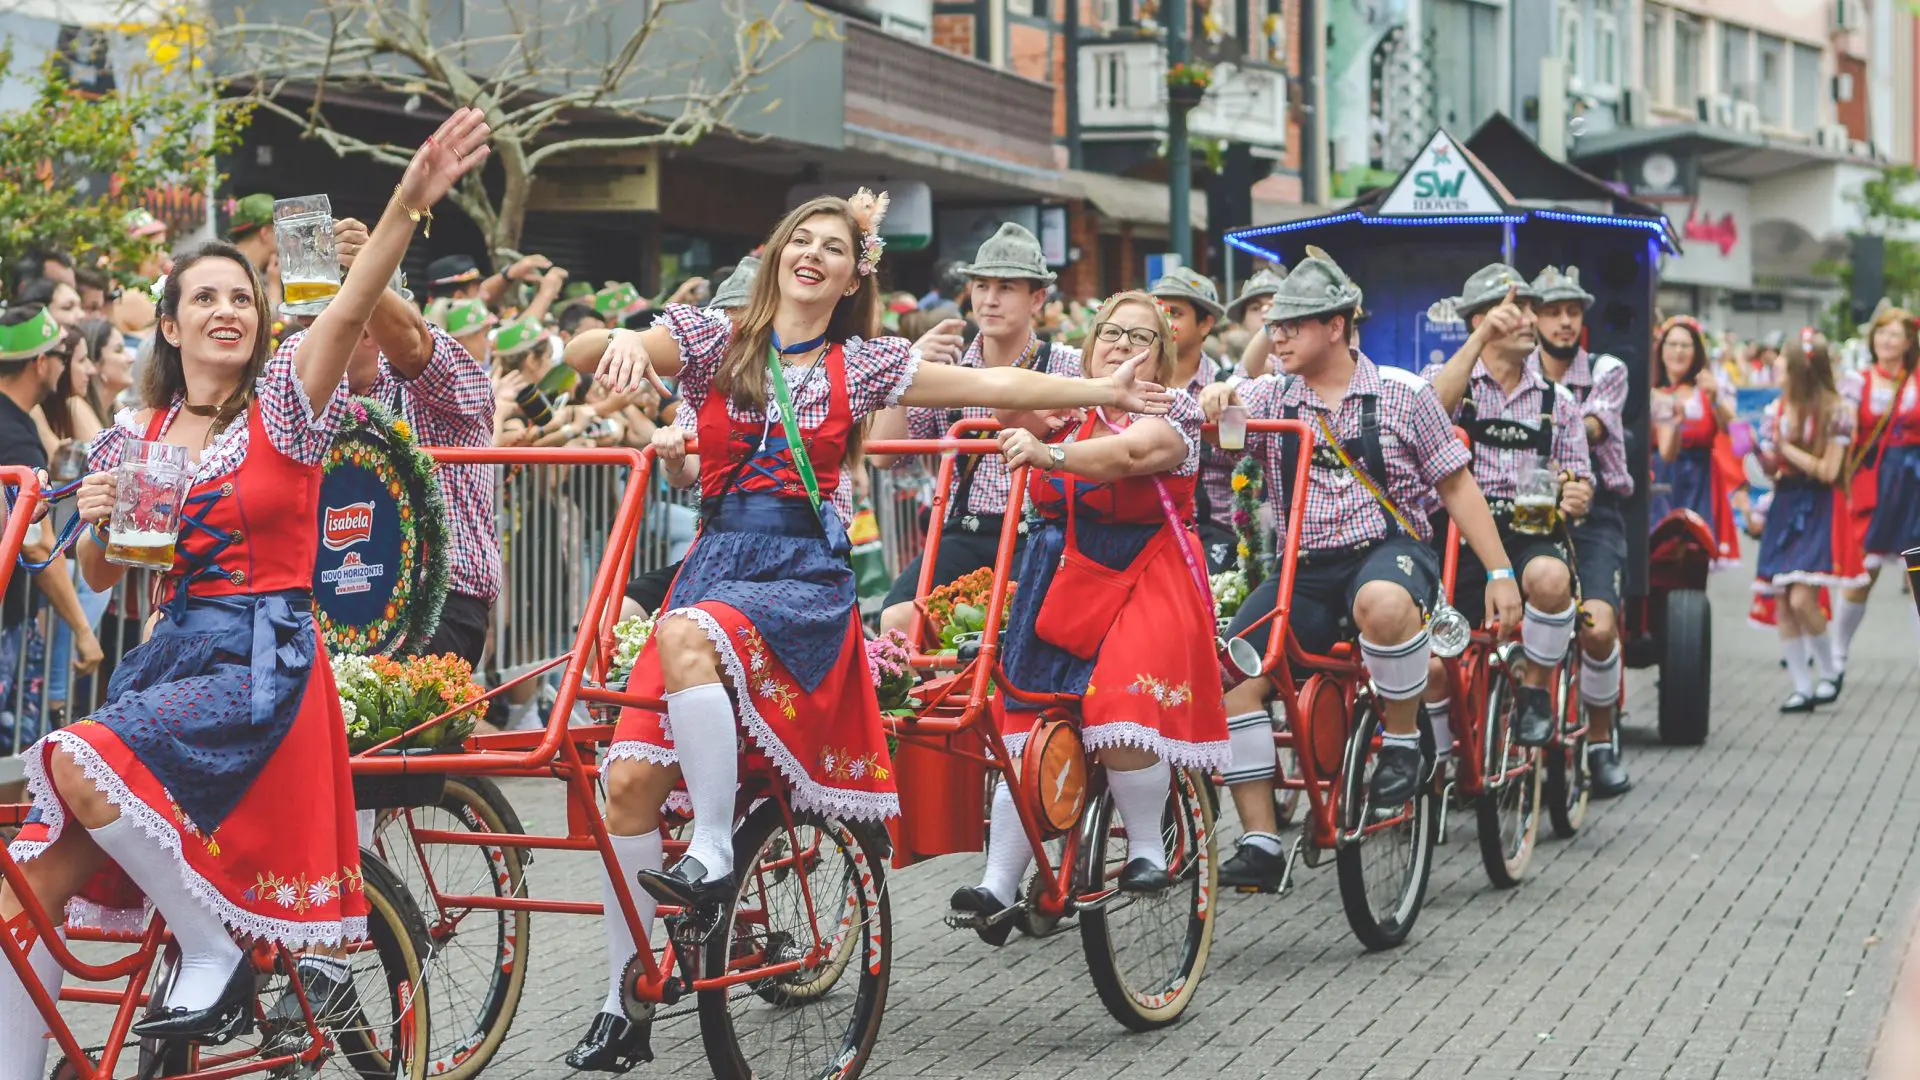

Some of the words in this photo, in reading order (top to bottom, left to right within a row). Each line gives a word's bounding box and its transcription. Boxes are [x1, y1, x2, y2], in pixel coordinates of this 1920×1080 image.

[1414, 170, 1467, 198] SW
[328, 511, 369, 531] isabela
[322, 570, 342, 581] NOVO
[343, 565, 383, 579] HORIZONTE
